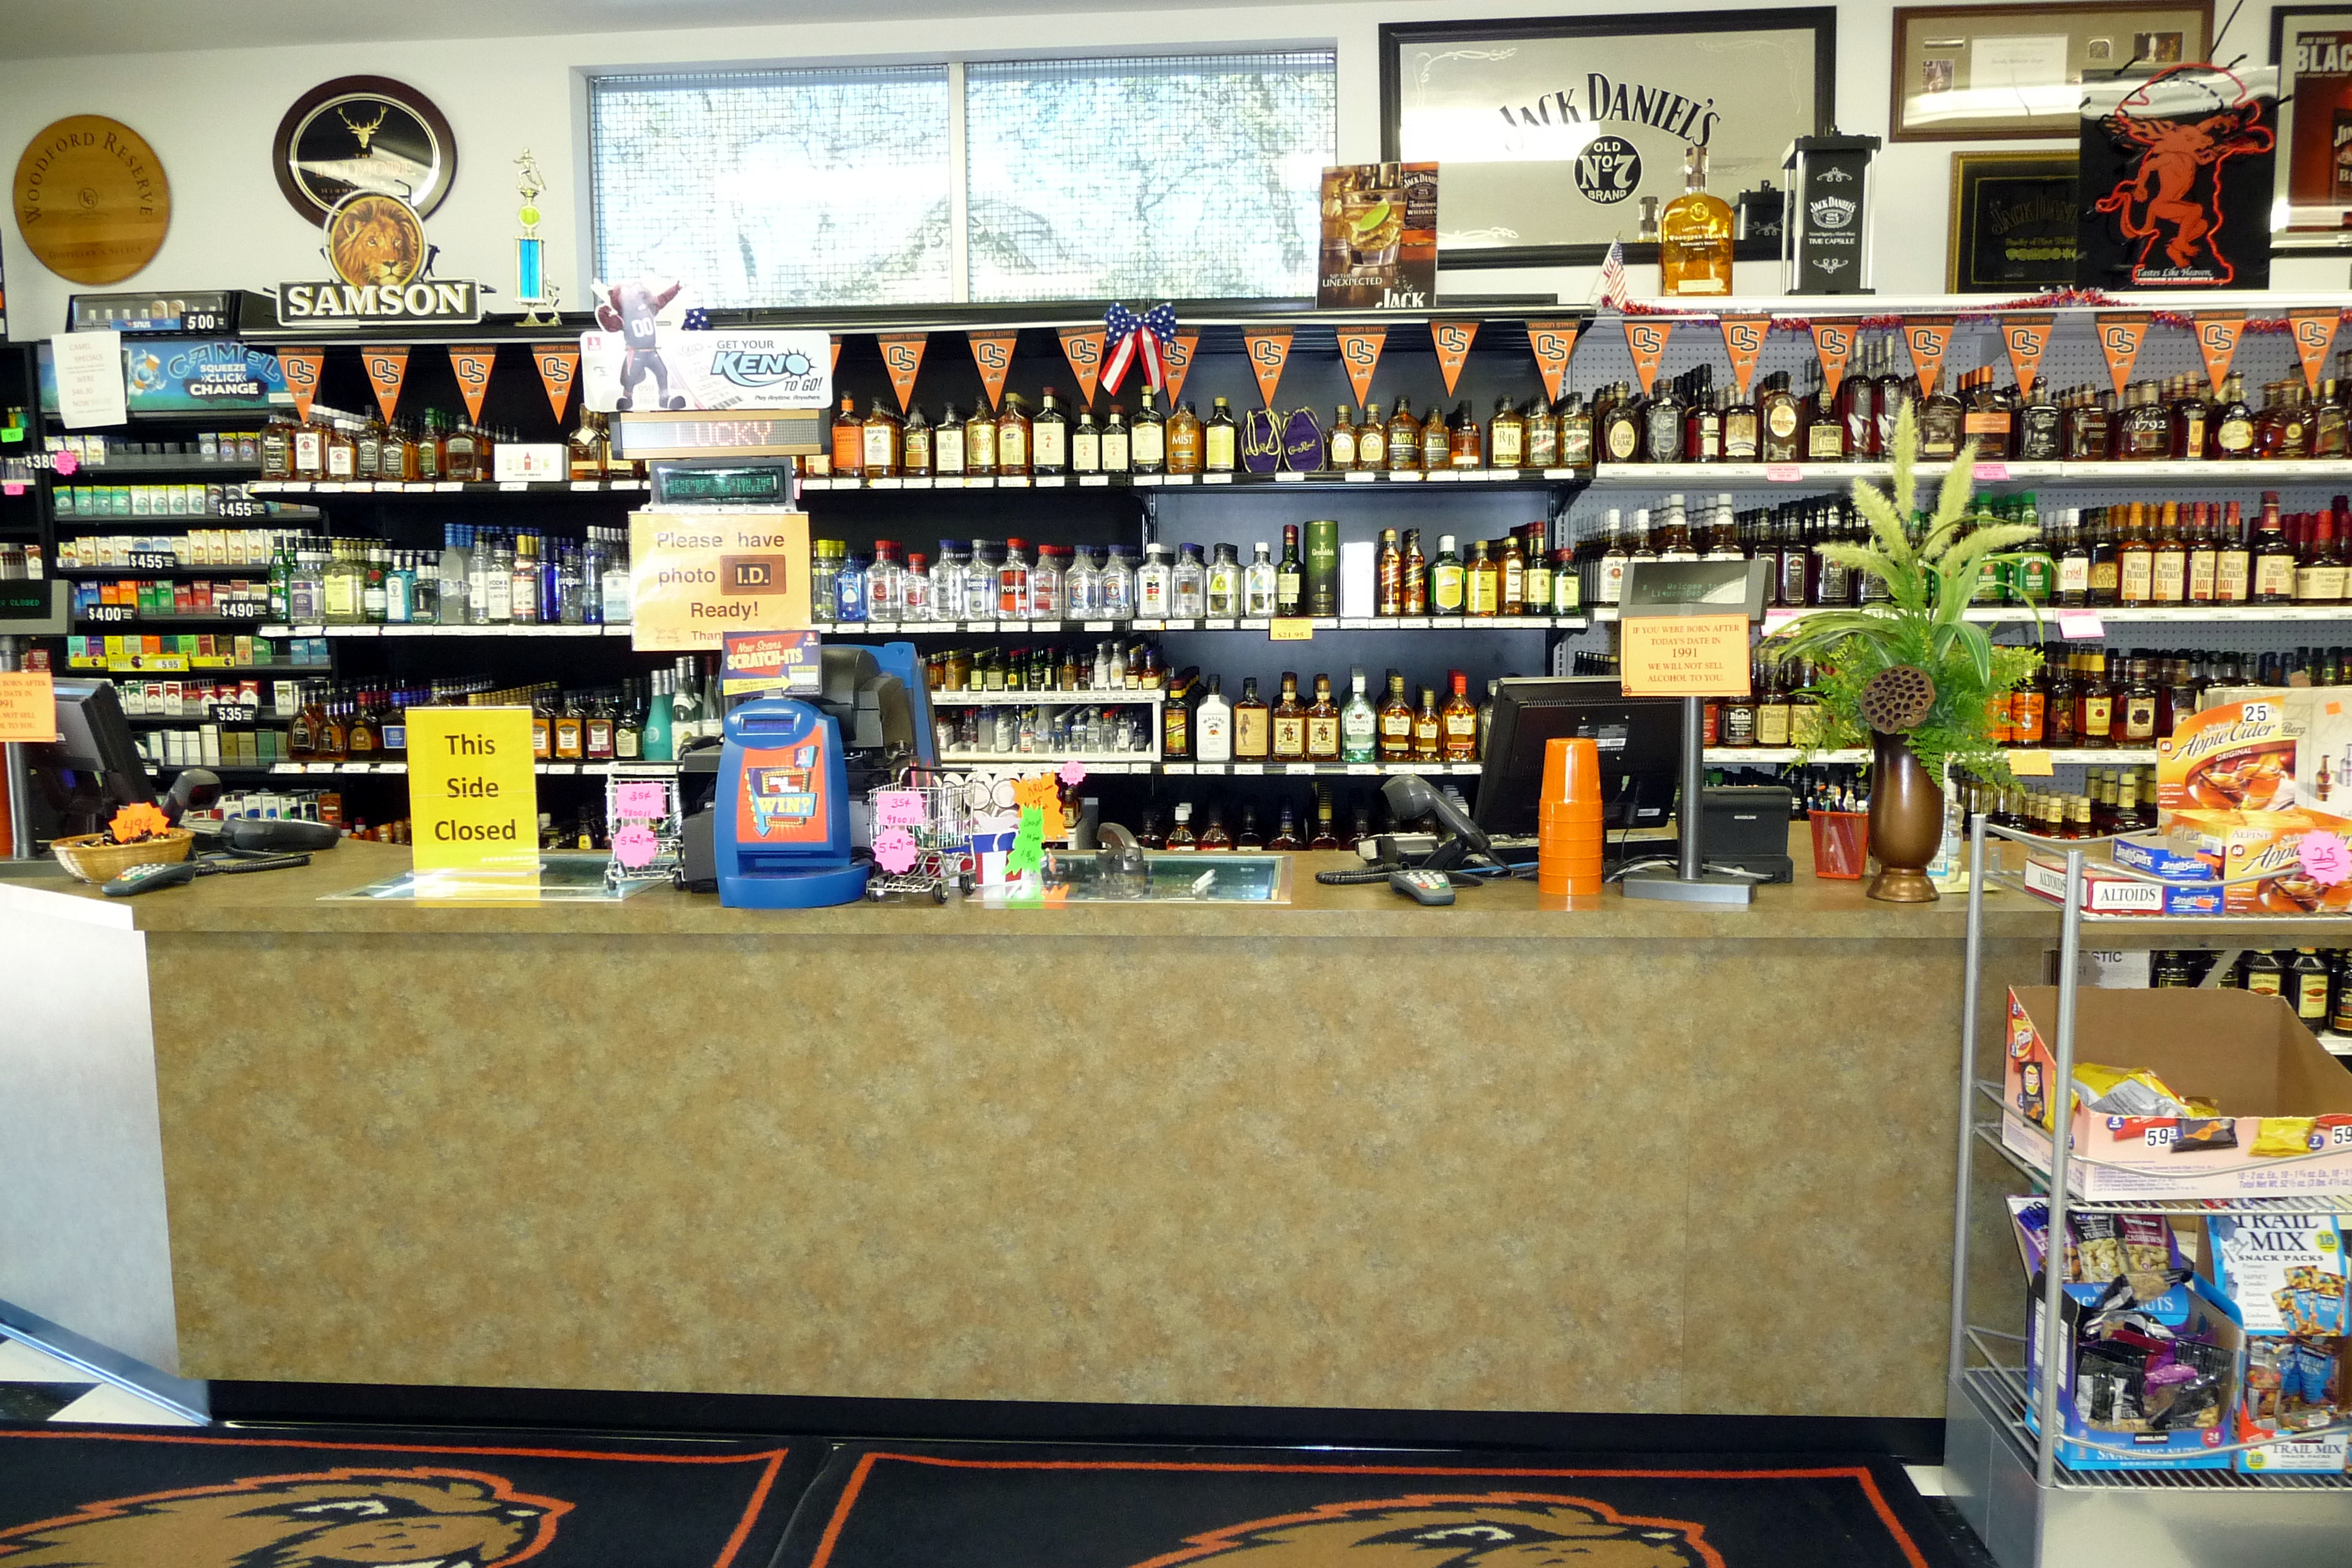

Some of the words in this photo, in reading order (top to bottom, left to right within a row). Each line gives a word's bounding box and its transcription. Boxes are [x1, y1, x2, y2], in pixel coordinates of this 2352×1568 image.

[1498, 88, 1581, 141] JACK
[1587, 73, 1721, 147] DANIEL'S
[1593, 142, 1621, 152] OLD
[315, 160, 416, 178] DALMORE
[24, 132, 95, 225] WOODFORD
[103, 131, 153, 217] RESERVE
[1587, 190, 1627, 202] BRAND
[1810, 198, 1828, 214] JACK
[1828, 195, 1857, 213] DANIEL'S
[2135, 268, 2161, 277] Tastes
[2162, 268, 2180, 277] Like
[1322, 276, 1383, 287] UNEXPECTED
[287, 283, 470, 317] SAMSON
[1375, 288, 1426, 309] JACK
[631, 317, 654, 338] 00
[717, 340, 739, 350] GET
[741, 340, 775, 349] YOUR
[200, 363, 247, 374] SQUEEZE
[710, 349, 815, 378] KENO
[189, 382, 259, 396] CHANGE
[785, 377, 798, 392] TO
[801, 376, 823, 392] GO!
[2132, 420, 2166, 430] 1792
[675, 420, 773, 446] LUCKY
[1171, 433, 1193, 445] MIST
[1612, 439, 1632, 447] CRAIG
[669, 479, 711, 487] REMEMBER
[737, 485, 766, 493] TICKET
[657, 532, 724, 548] Please
[737, 531, 785, 547] have
[2130, 562, 2147, 570] WILD
[2161, 562, 2177, 570] WILD
[2223, 561, 2241, 570] WILD
[2269, 562, 2283, 570] WILD
[658, 567, 717, 586] photo
[737, 567, 770, 585] I.D.
[2065, 567, 2082, 577] red
[2126, 570, 2148, 579] TURKEY
[2157, 570, 2180, 579] TURKEY
[2220, 570, 2243, 578] TURKEY
[1667, 581, 1703, 590] Welcome
[2125, 580, 2137, 590] 81
[2156, 580, 2168, 590] 81
[2195, 580, 2209, 590] 101
[2220, 580, 2233, 590] 101
[2265, 577, 2277, 586] 101
[1001, 584, 1025, 594] POPOV
[691, 601, 759, 621] Ready!
[1632, 626, 1642, 635] IF
[1642, 626, 1660, 635] YOU
[1661, 626, 1685, 634] WERE
[1712, 624, 1740, 632] AFTER
[1651, 637, 1685, 645] TODAY'S
[1711, 636, 1721, 645] IN
[737, 642, 756, 653] Now
[756, 640, 782, 652] Scans
[1671, 648, 1698, 658] 1991
[727, 648, 804, 671] SCRATCH-ITS
[1704, 662, 1724, 670] SELL
[1648, 674, 1687, 682] ALCOHOL
[1690, 674, 1703, 682] TO
[2245, 705, 2267, 723] 25
[444, 733, 496, 755] This
[2171, 732, 2229, 761] Apple
[2230, 720, 2276, 742] Cider
[2216, 746, 2252, 762] ORIGINAL
[446, 777, 499, 799] Side
[757, 795, 812, 814] WIN?
[434, 819, 517, 841] Closed
[2231, 829, 2272, 840] ALPINE
[2101, 887, 2156, 902] ALTOIDS
[2146, 1129, 2168, 1147] 59
[2236, 1214, 2319, 1229] TRAIL
[2082, 1229, 2115, 1240] PEANUTS
[2125, 1234, 2163, 1244] CASHEWS
[2318, 1233, 2335, 1246] 18
[2248, 1231, 2309, 1252] MIX
[2207, 1432, 2220, 1442] 24
[2273, 1444, 2314, 1454] TRAIL
[2315, 1444, 2343, 1454] MIX
[2249, 1454, 2264, 1464] 18
